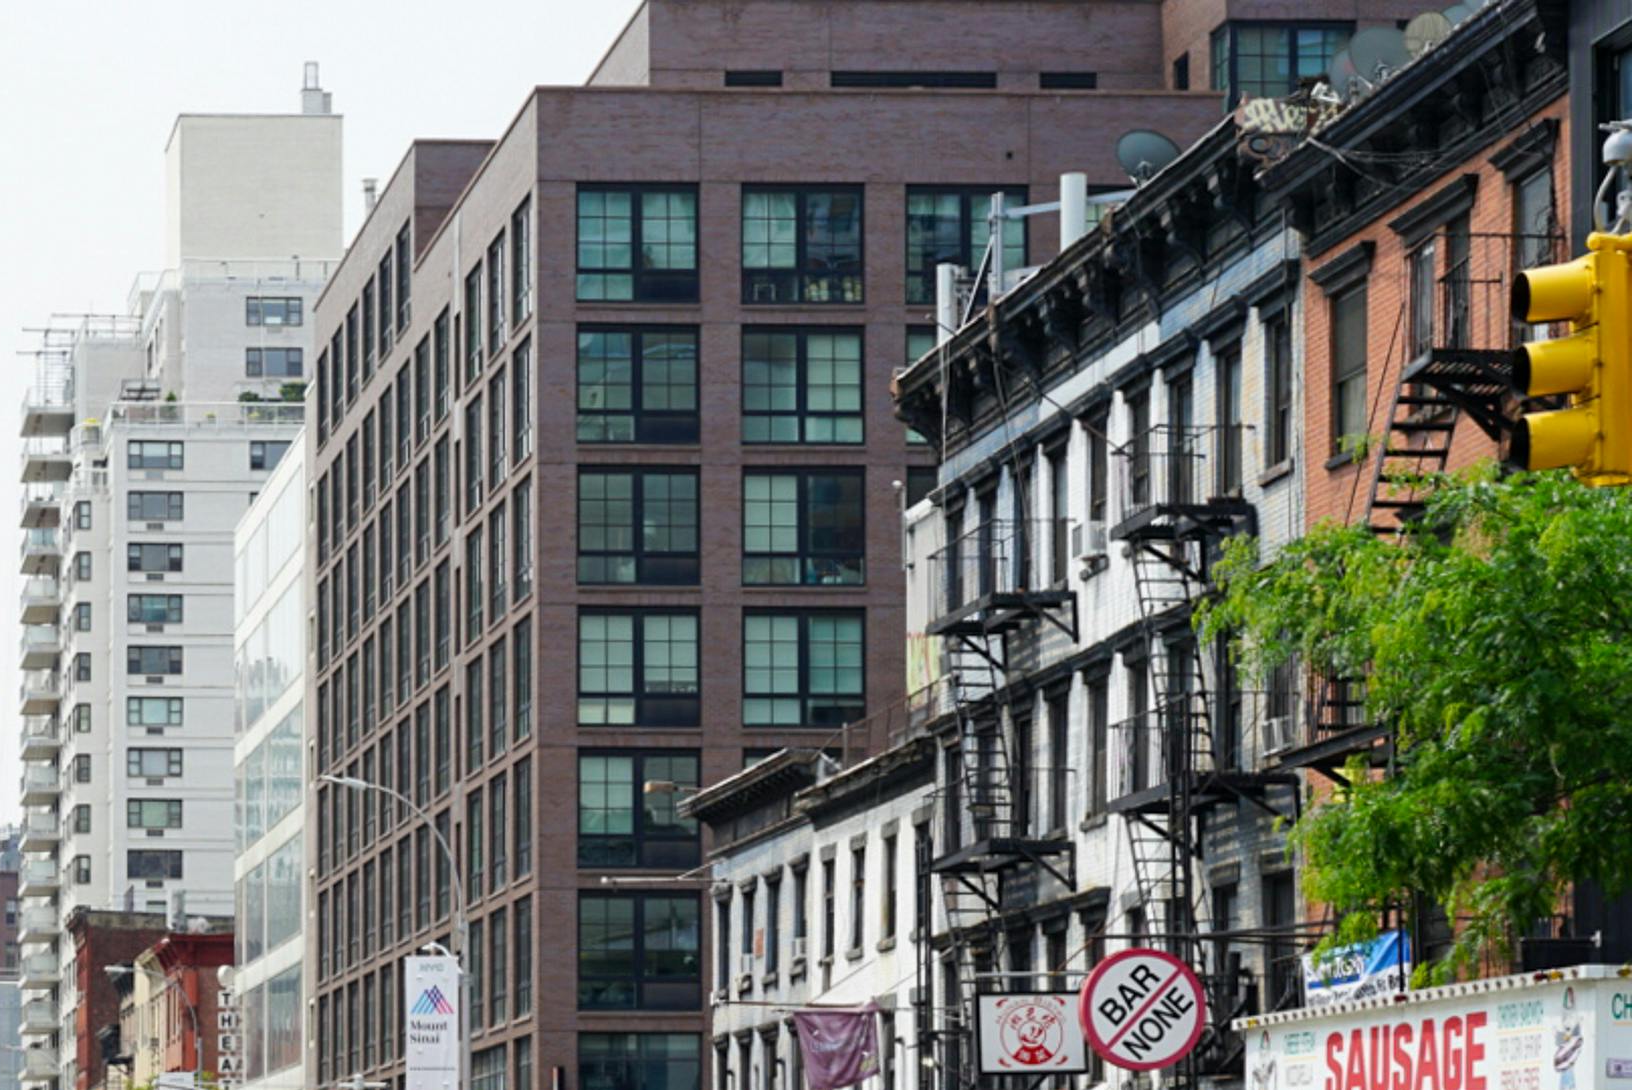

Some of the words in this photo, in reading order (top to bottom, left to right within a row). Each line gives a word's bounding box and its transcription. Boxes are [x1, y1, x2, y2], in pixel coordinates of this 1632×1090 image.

[1098, 964, 1161, 1027] BAR
[410, 1020, 447, 1031] Mount
[410, 1033, 440, 1044] Sinai
[1122, 986, 1194, 1061] NONE
